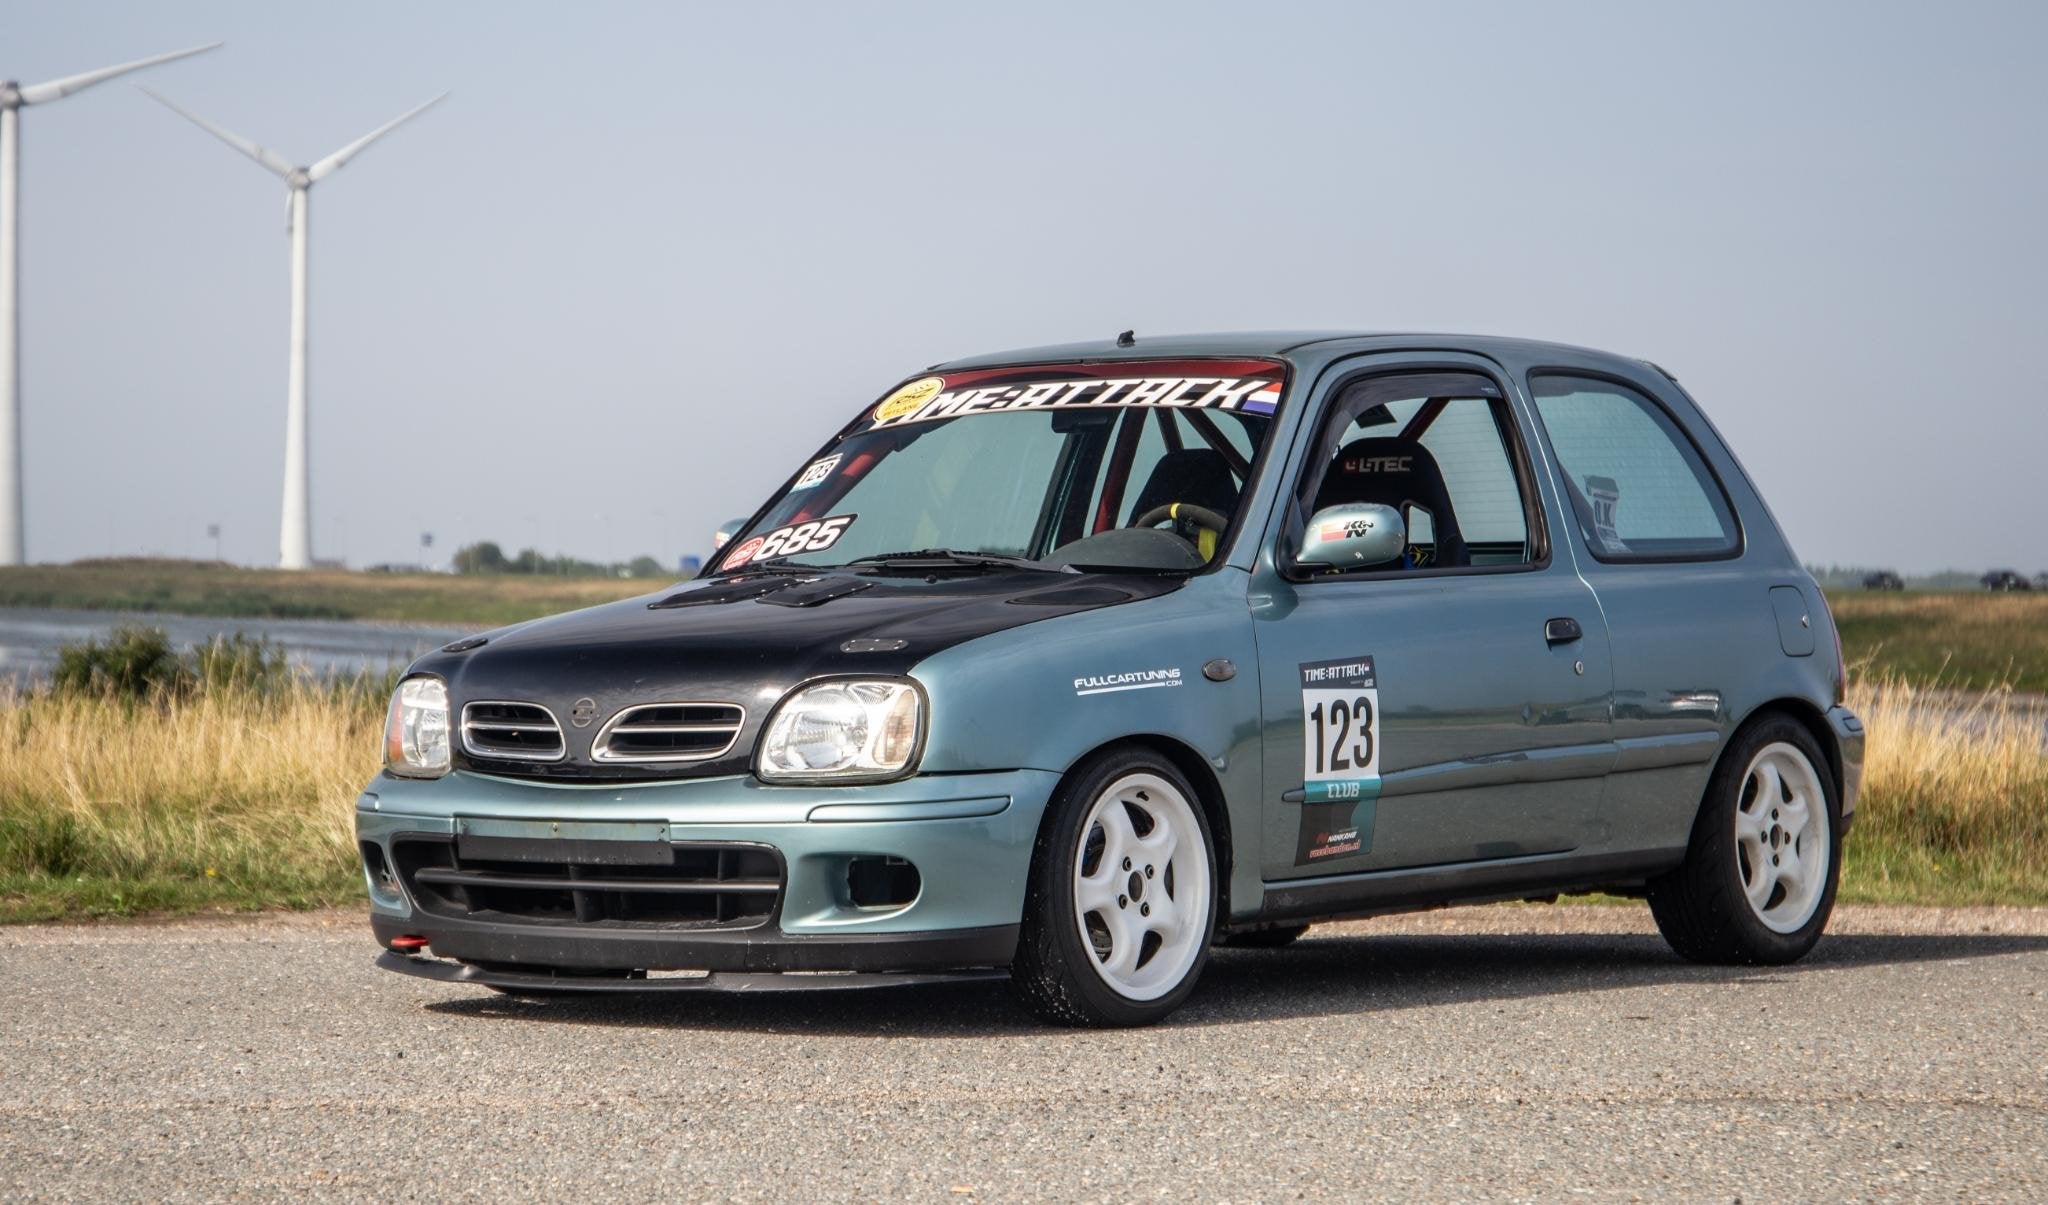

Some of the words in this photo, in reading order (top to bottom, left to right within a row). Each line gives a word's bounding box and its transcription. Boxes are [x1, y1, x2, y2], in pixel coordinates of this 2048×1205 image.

[867, 378, 1267, 430] IME:ATTACK
[800, 461, 835, 485] 123
[751, 517, 850, 561] 685
[1074, 668, 1181, 689] FULLCARTUNING
[1304, 664, 1365, 682] TIME:ATTACK
[1310, 696, 1373, 774] 123
[1327, 782, 1360, 798] CLUB
